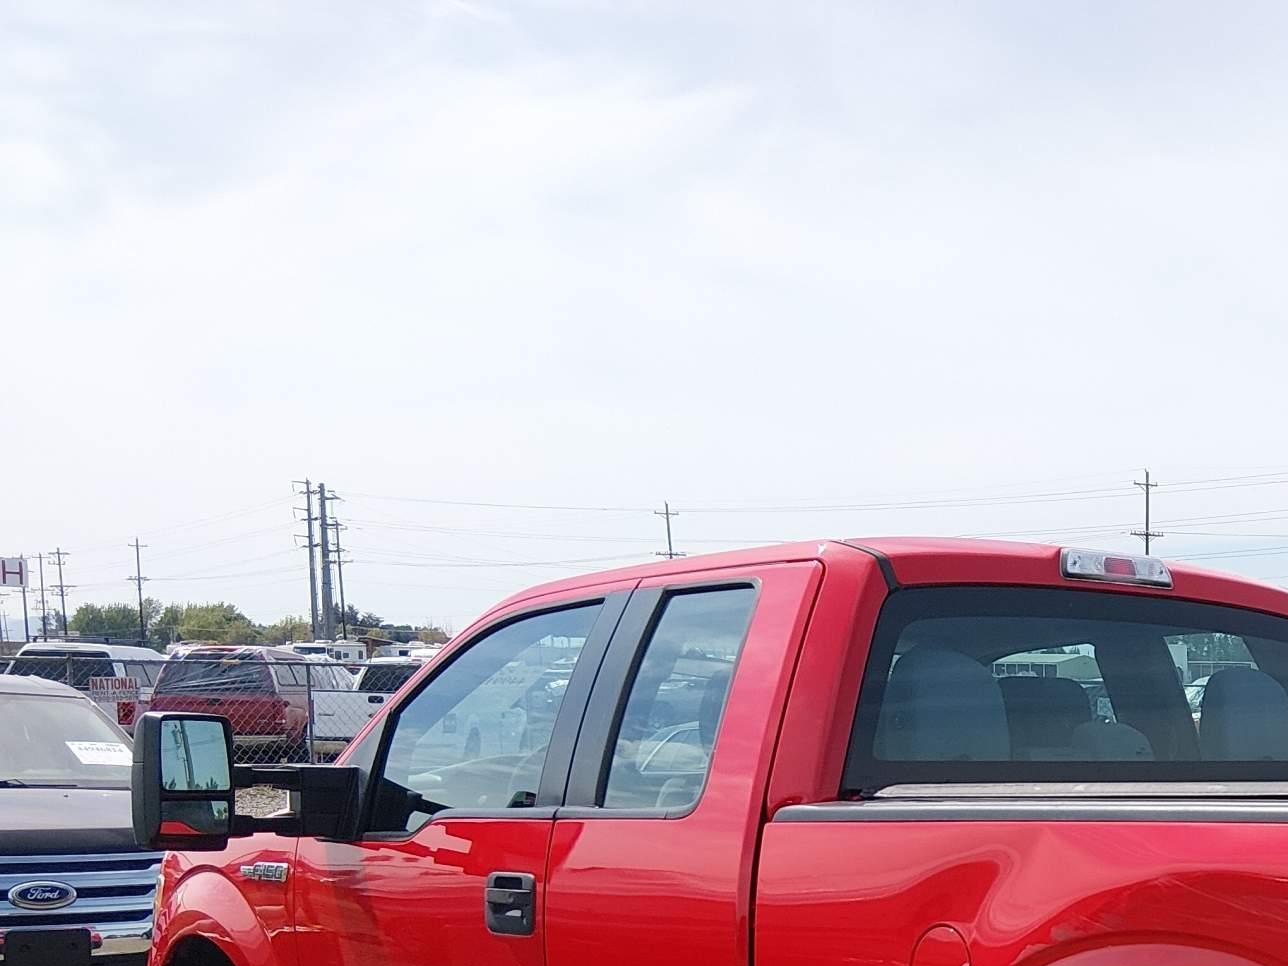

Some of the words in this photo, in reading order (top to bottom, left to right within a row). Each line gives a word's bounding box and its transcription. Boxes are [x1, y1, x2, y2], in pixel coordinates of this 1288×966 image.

[1, 559, 24, 585] H
[91, 678, 140, 690] NATIONAL
[27, 887, 60, 900] Ford
